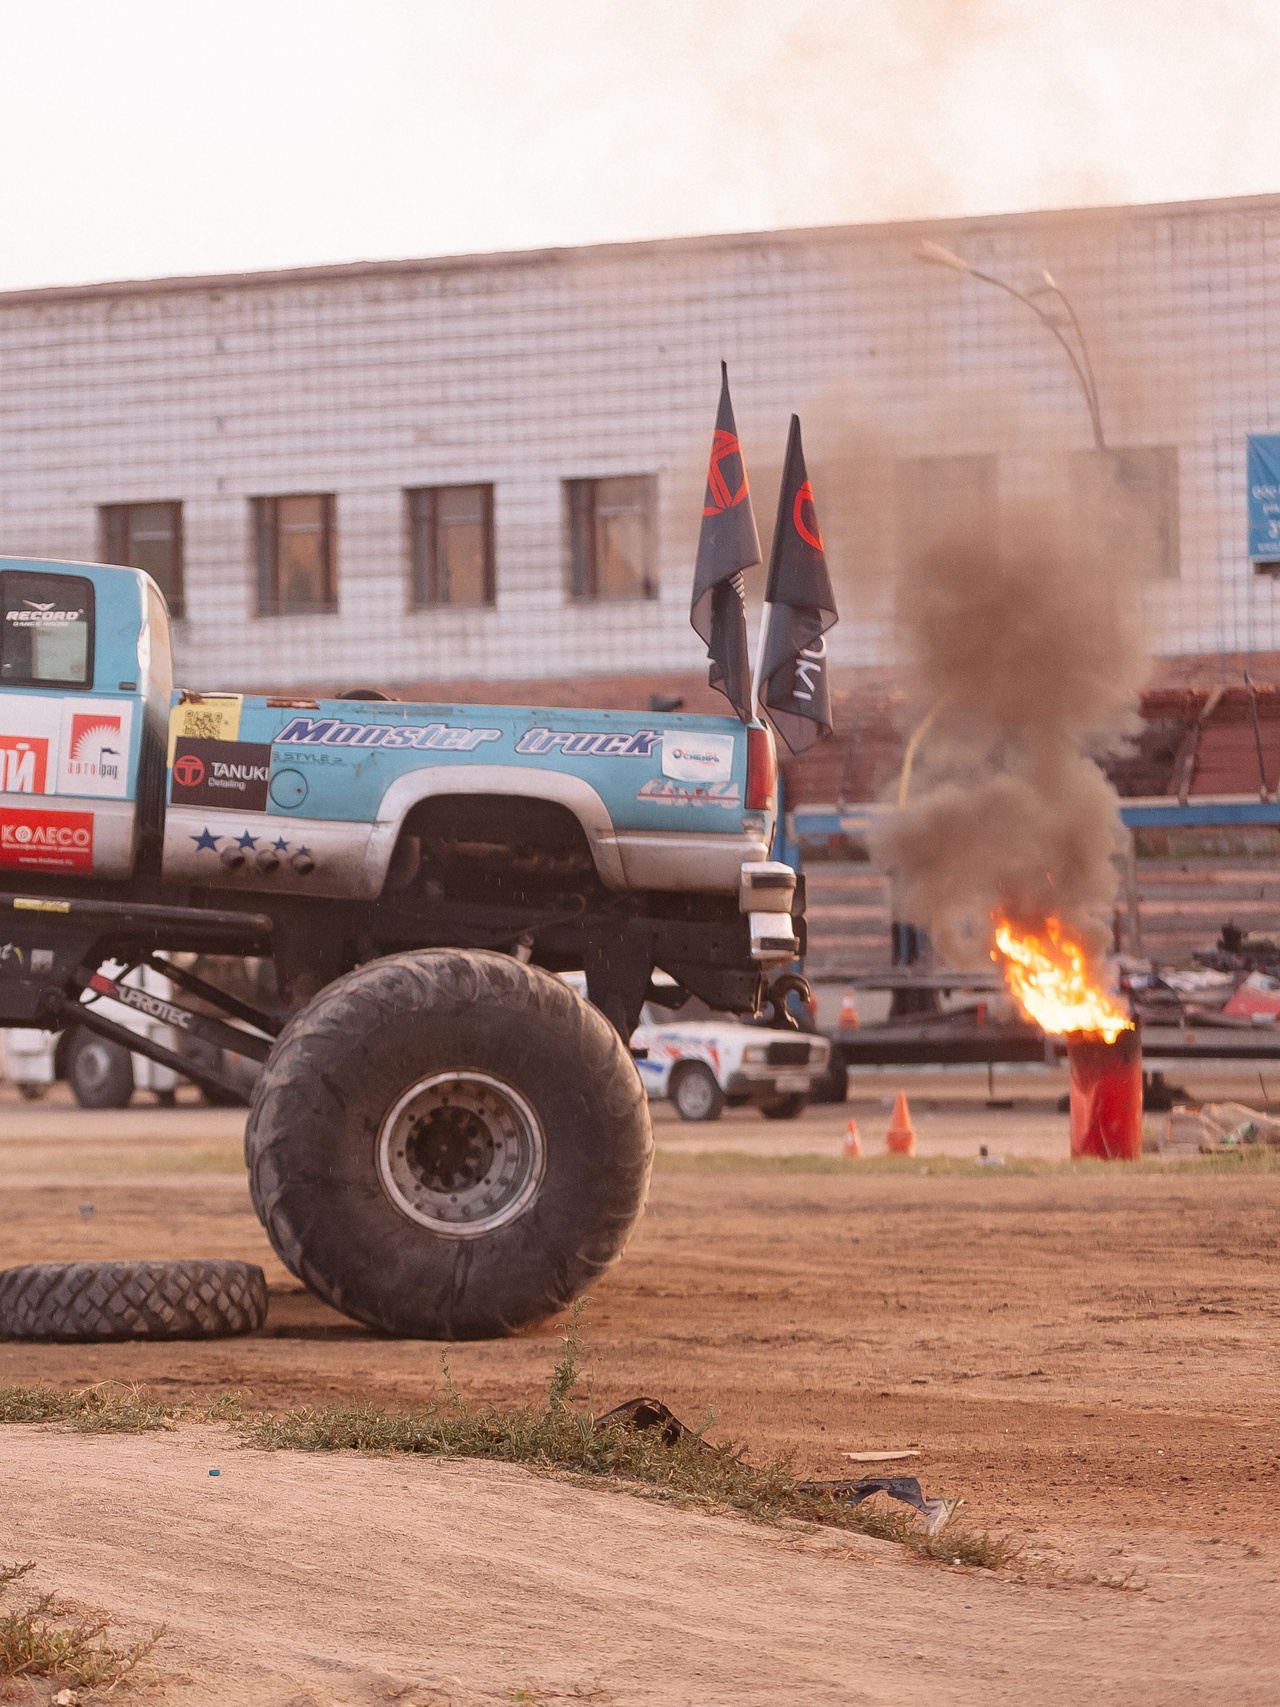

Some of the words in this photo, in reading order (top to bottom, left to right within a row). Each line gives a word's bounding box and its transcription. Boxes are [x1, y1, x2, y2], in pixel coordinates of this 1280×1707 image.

[6, 611, 79, 621] RECORD
[274, 717, 503, 751] Monster
[211, 762, 270, 781] TANUKI
[208, 777, 246, 791] Detailing
[1, 824, 91, 847] КОЛЕСО
